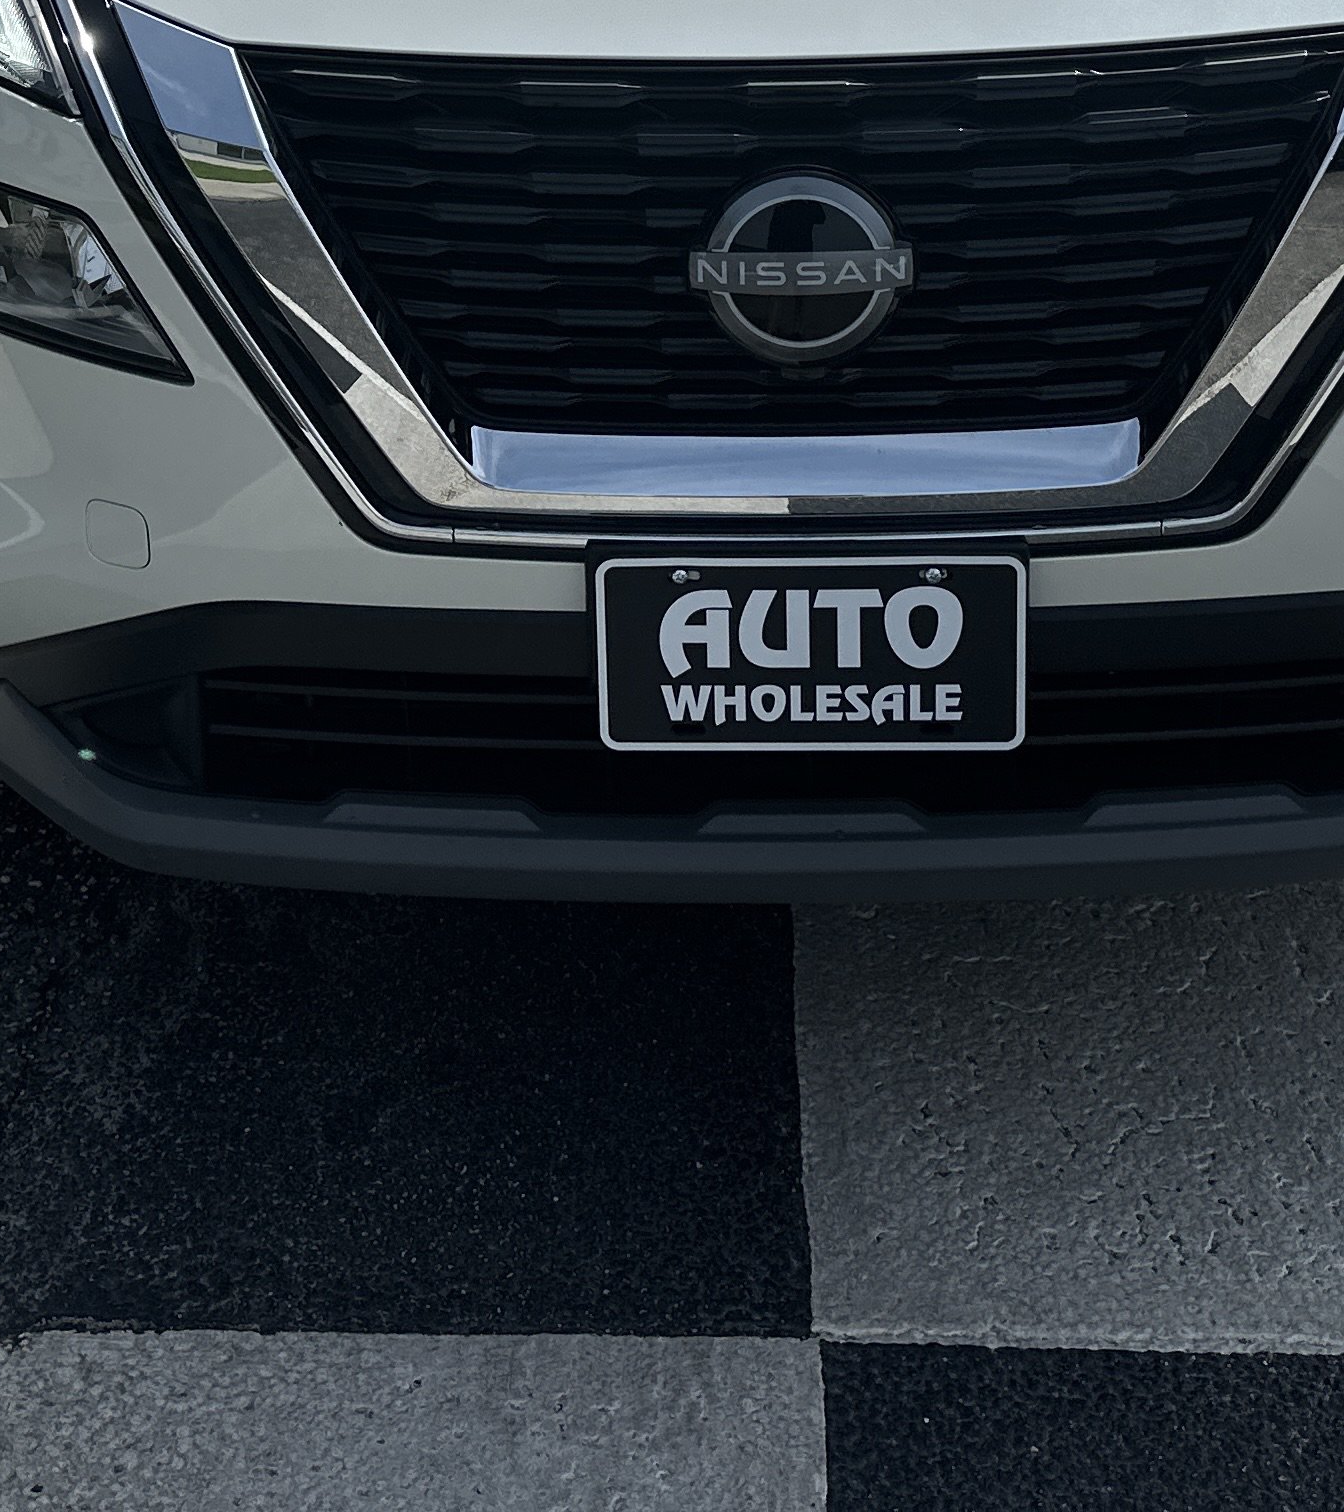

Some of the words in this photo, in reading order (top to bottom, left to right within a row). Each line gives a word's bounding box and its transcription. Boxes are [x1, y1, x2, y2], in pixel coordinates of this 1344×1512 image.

[695, 255, 909, 288] NISSAN
[658, 585, 965, 679] AUTO
[660, 683, 964, 726] WHOLESALE
